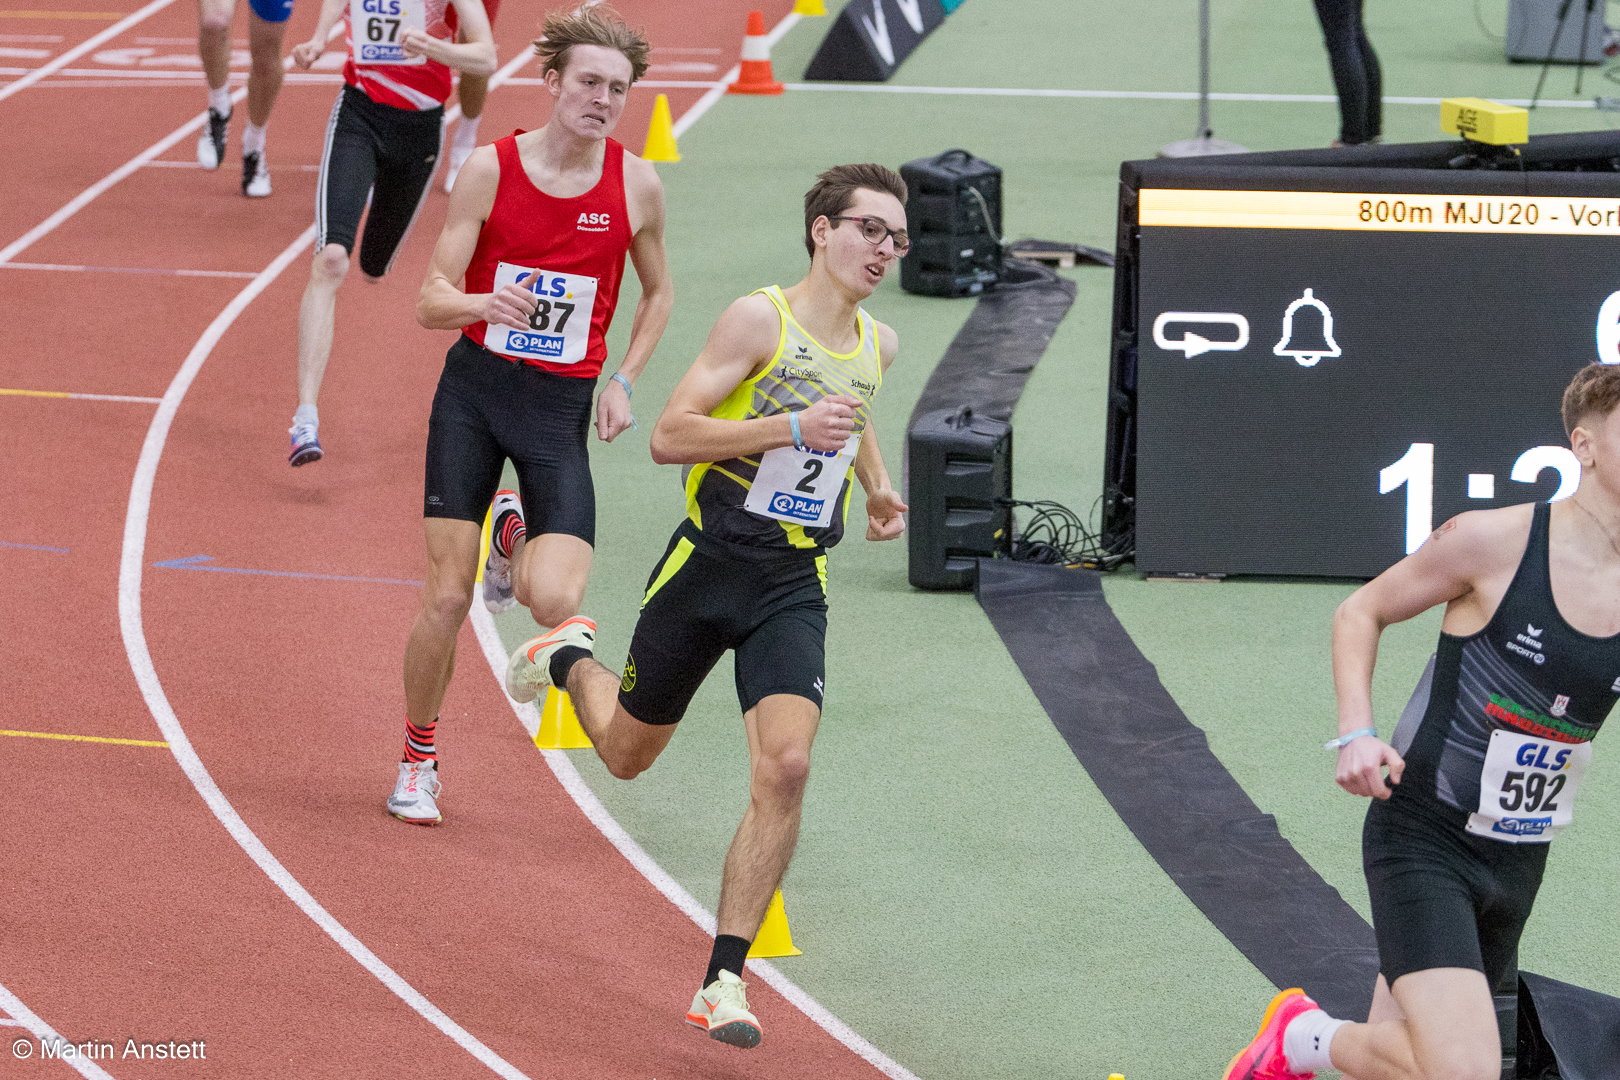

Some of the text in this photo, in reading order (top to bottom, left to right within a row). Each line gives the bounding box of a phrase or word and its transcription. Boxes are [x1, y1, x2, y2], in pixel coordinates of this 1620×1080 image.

[367, 17, 401, 42] 67
[577, 212, 611, 225] ASC
[1359, 200, 1432, 223] 800m
[1445, 202, 1539, 225] MJU20
[530, 337, 562, 350] PLAN
[795, 458, 824, 494] 2
[794, 500, 823, 514] PLAN
[1516, 633, 1543, 651] erima
[1499, 770, 1567, 812] 592
